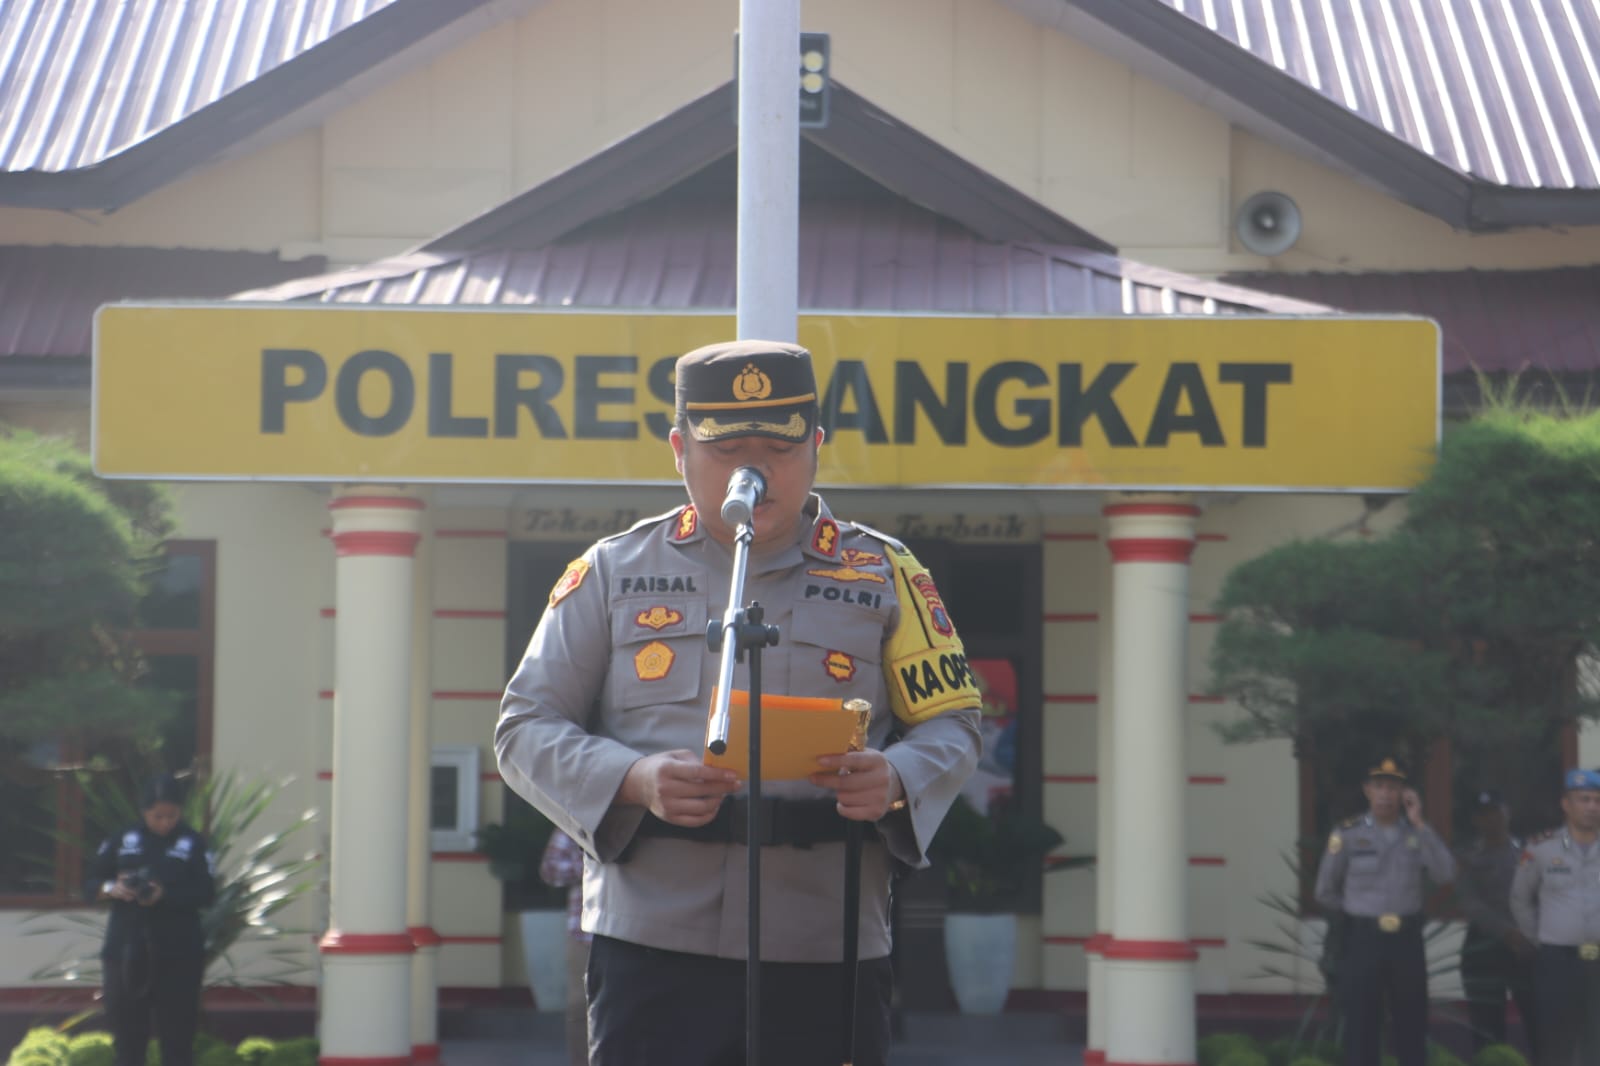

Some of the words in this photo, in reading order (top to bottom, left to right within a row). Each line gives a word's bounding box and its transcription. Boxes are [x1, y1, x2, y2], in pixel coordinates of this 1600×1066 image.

[820, 359, 1293, 448] ANGKAT
[620, 575, 697, 594] FAISAL
[804, 584, 882, 609] POLRI
[901, 659, 945, 704] KA
